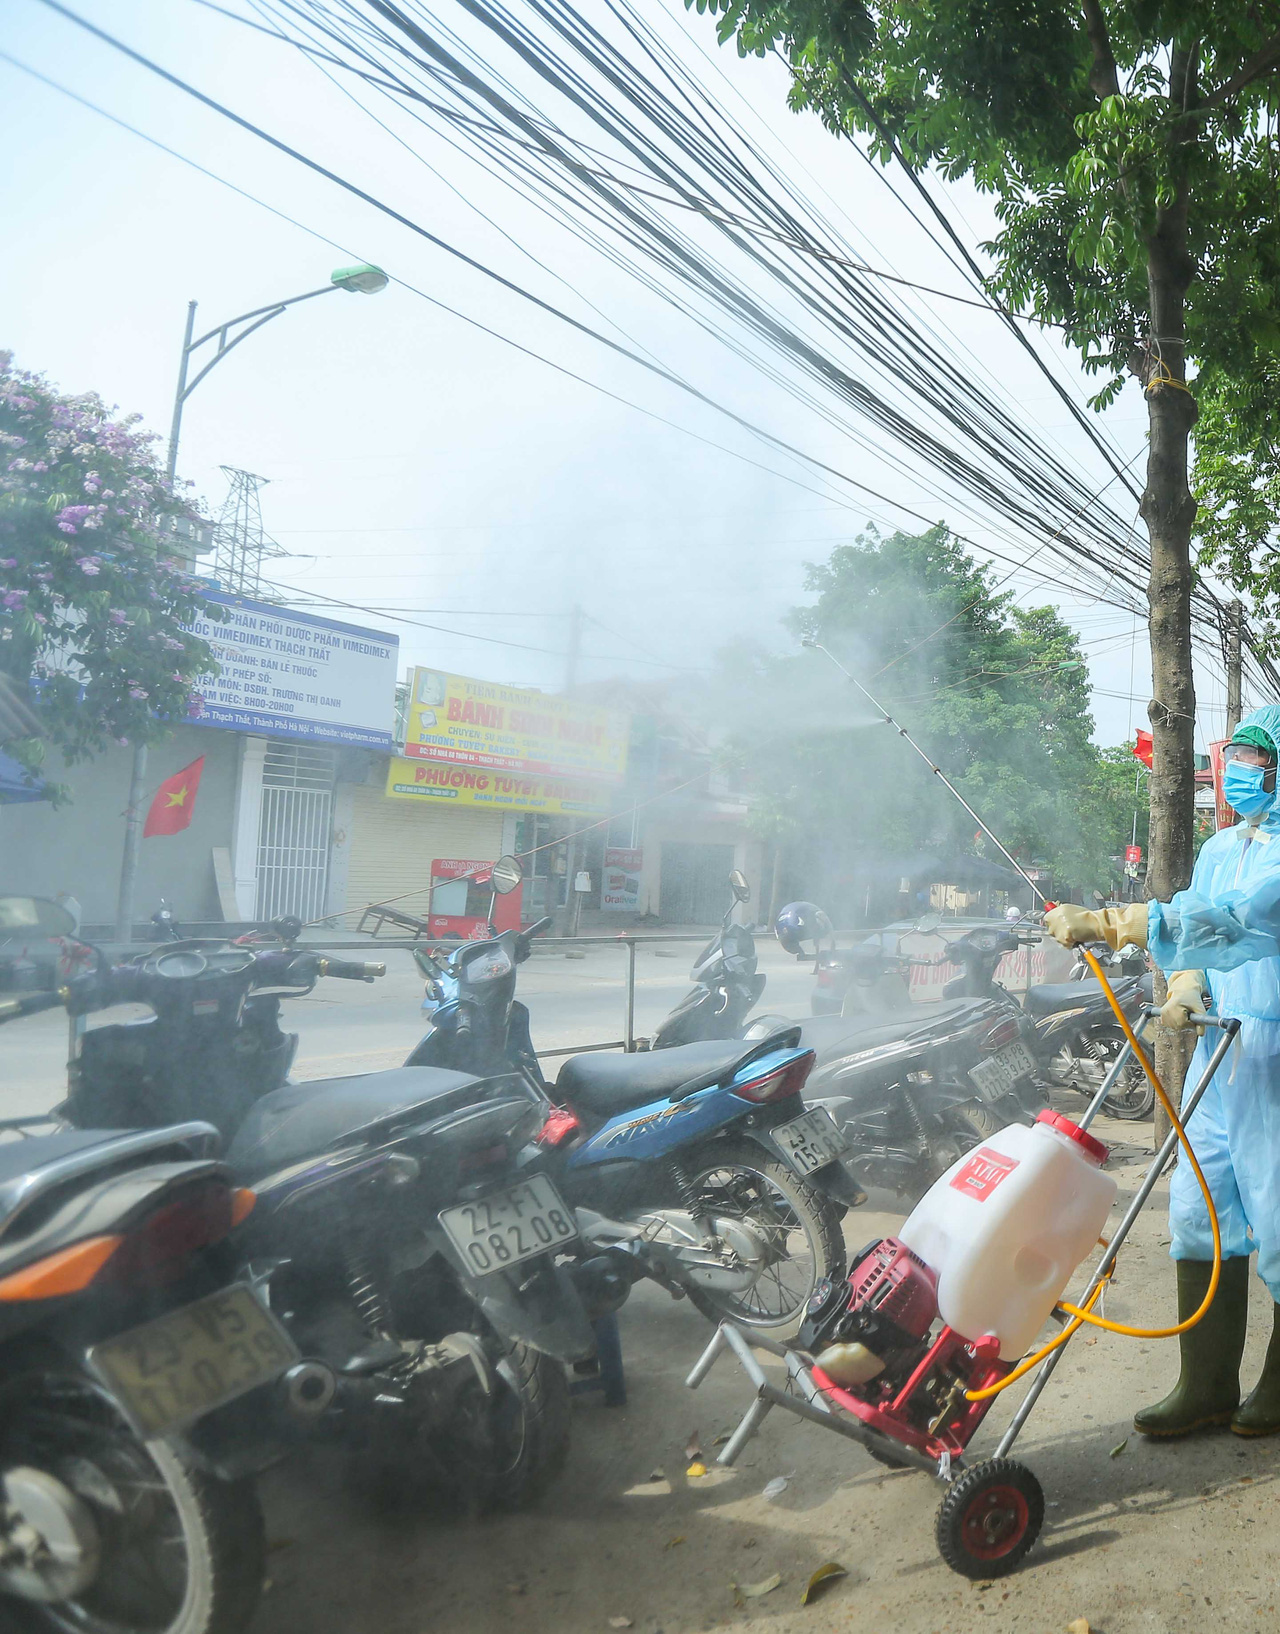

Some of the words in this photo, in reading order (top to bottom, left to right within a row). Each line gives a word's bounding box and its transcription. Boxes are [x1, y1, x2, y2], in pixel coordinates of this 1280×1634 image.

[213, 626, 271, 649] VIMEDIMEX
[275, 639, 305, 656] THẠCH
[308, 645, 331, 661] THẤT
[259, 618, 283, 635] PHỐI
[285, 626, 311, 643] DƯỢC
[343, 639, 390, 660] VIMEDIMEX
[232, 667, 256, 680] PHÉP
[244, 697, 294, 713] 8H00-20H00
[321, 697, 341, 708] OANH
[447, 696, 504, 730] BÁNH
[782, 1112, 827, 1149] 29-V5
[461, 1184, 543, 1236] 22-F1
[467, 1209, 570, 1270] 082.08
